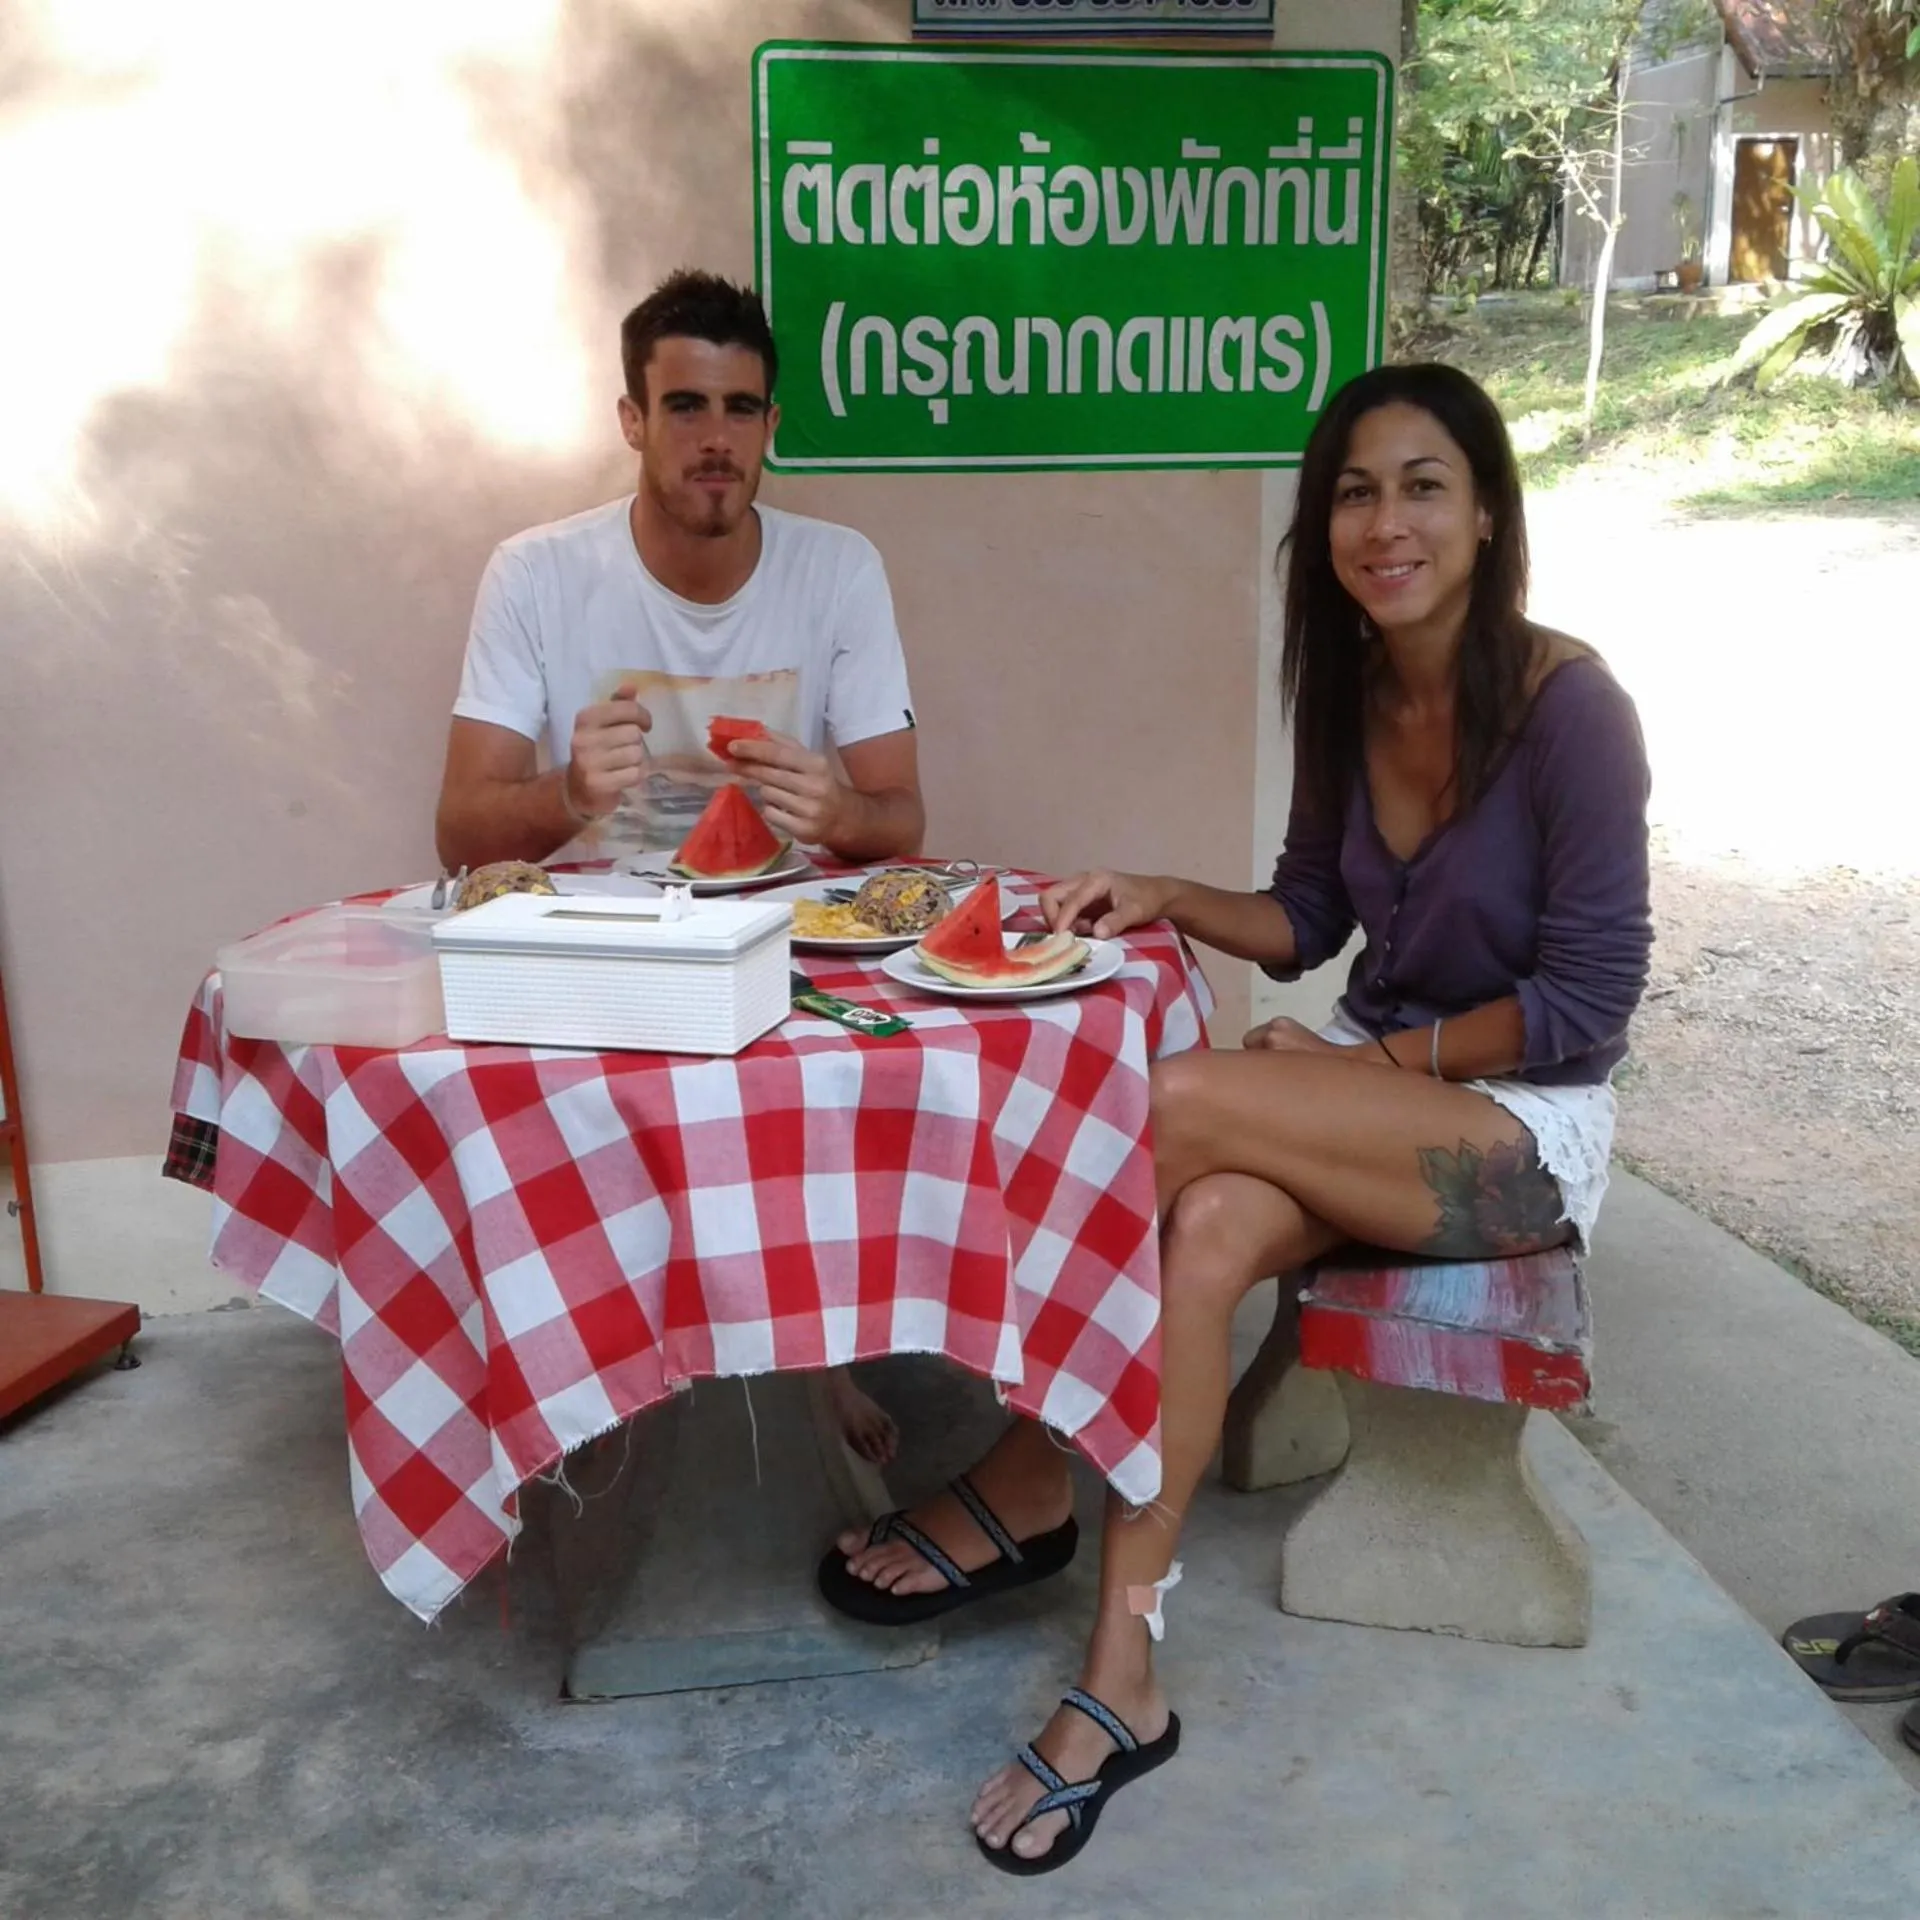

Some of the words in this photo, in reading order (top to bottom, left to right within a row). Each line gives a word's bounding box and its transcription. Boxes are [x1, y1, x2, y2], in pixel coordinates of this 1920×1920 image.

[781, 116, 1363, 246] ติดต่อห้องพักที่นี่
[821, 301, 1332, 425] (กรุณากดแตร)
